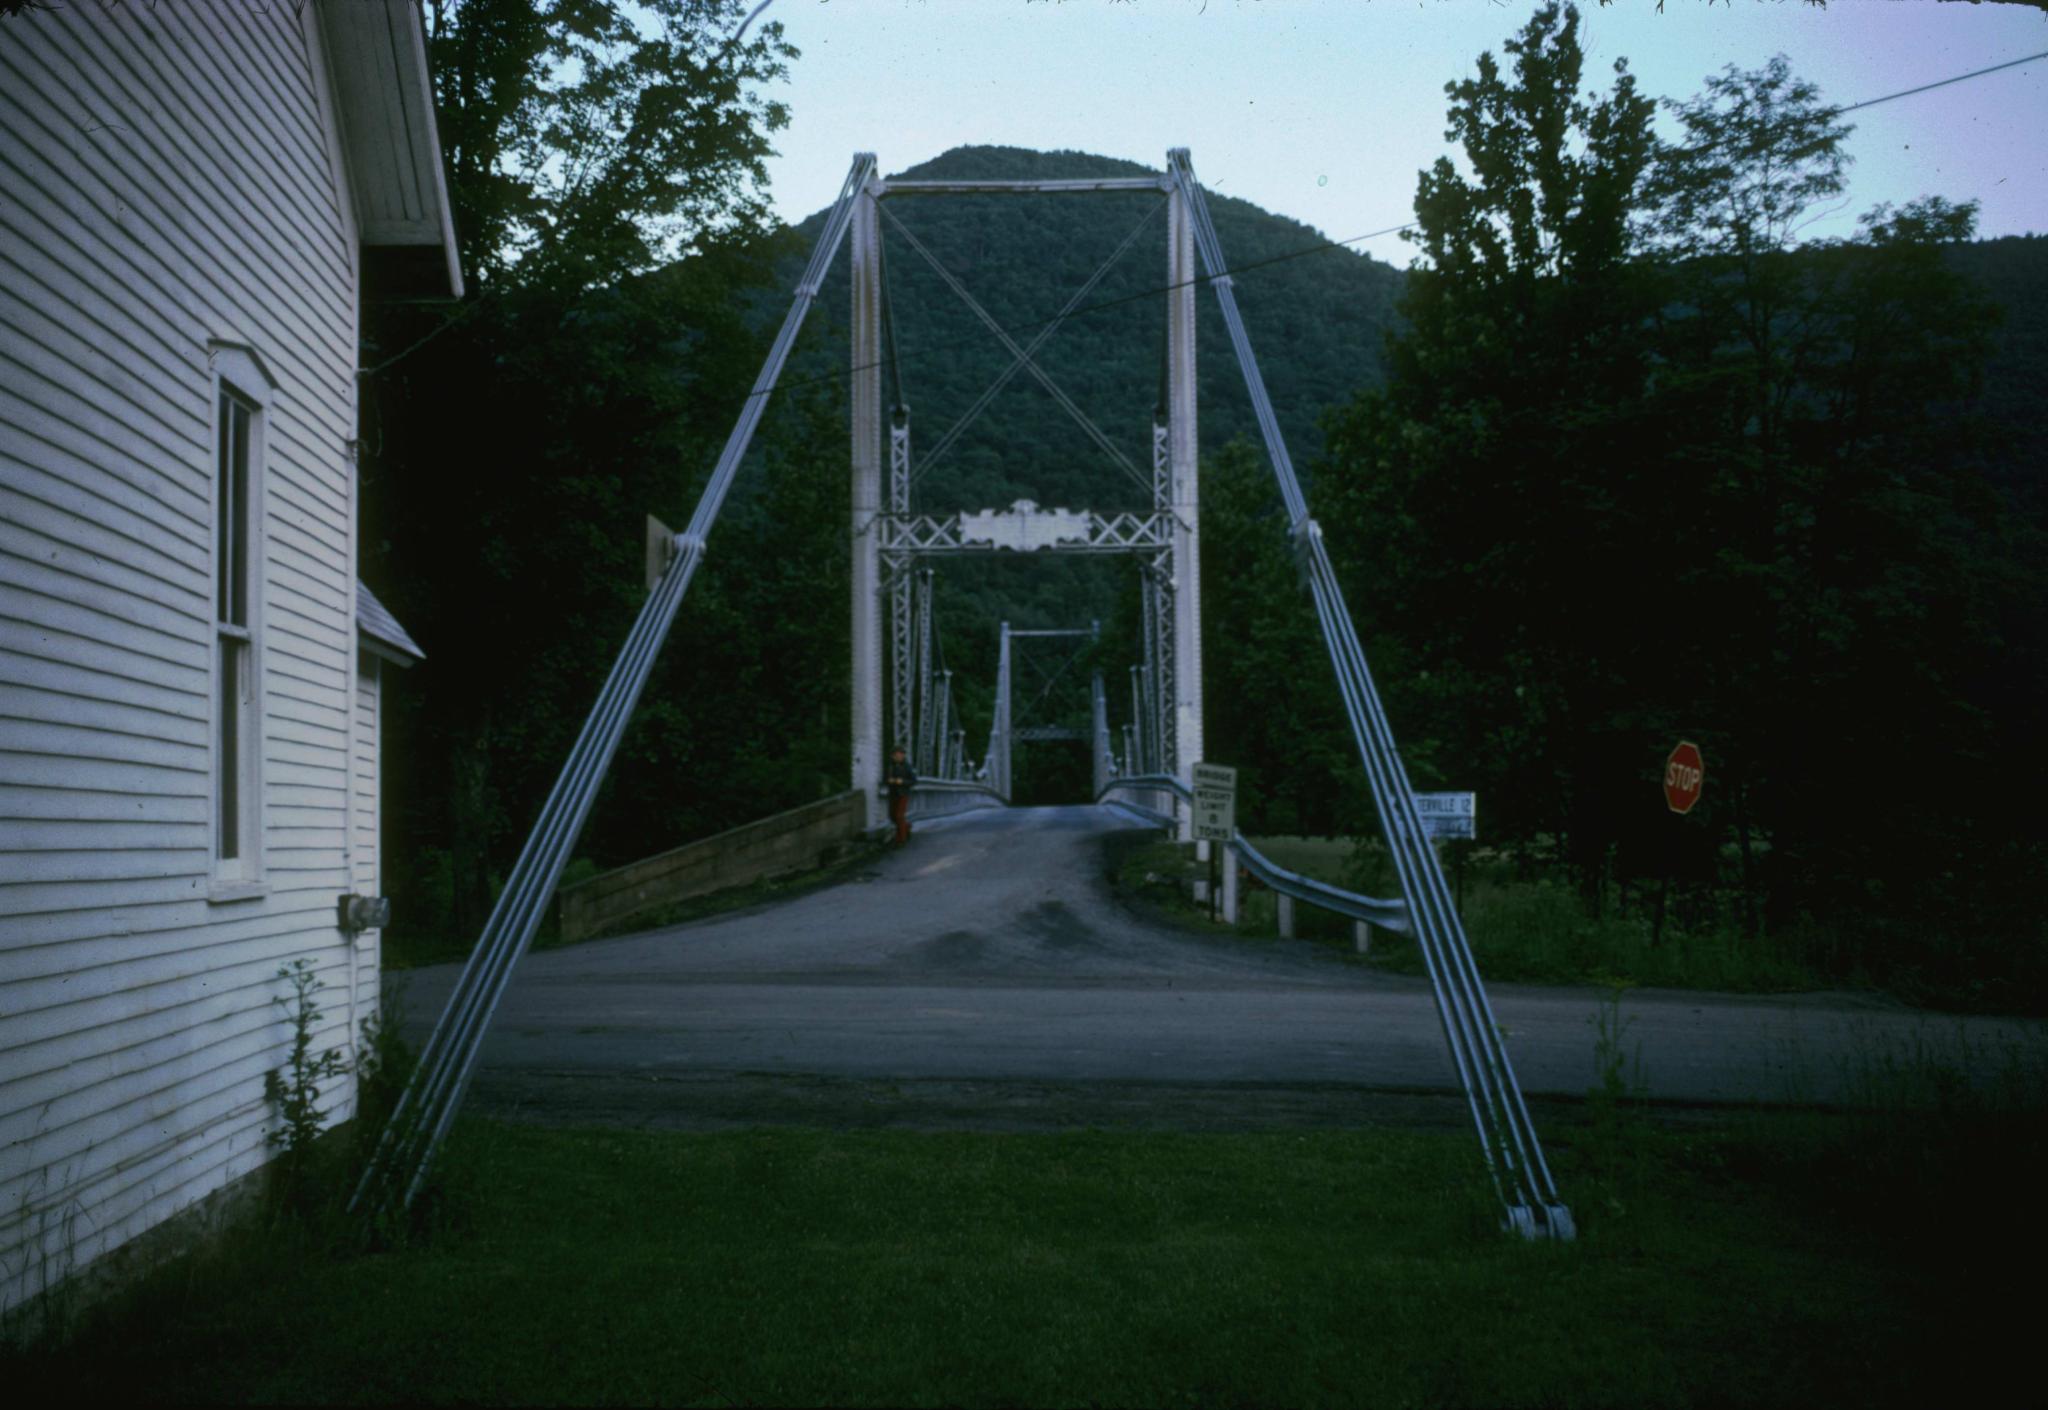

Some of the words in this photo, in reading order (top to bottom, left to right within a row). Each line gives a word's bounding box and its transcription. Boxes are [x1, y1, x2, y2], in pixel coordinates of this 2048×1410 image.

[1197, 769, 1232, 783] BRIDGE
[1667, 762, 1700, 792] STOP
[1197, 790, 1231, 801] WEIGHT
[1201, 802, 1226, 811] LIMIT
[1198, 825, 1228, 839] TONS
